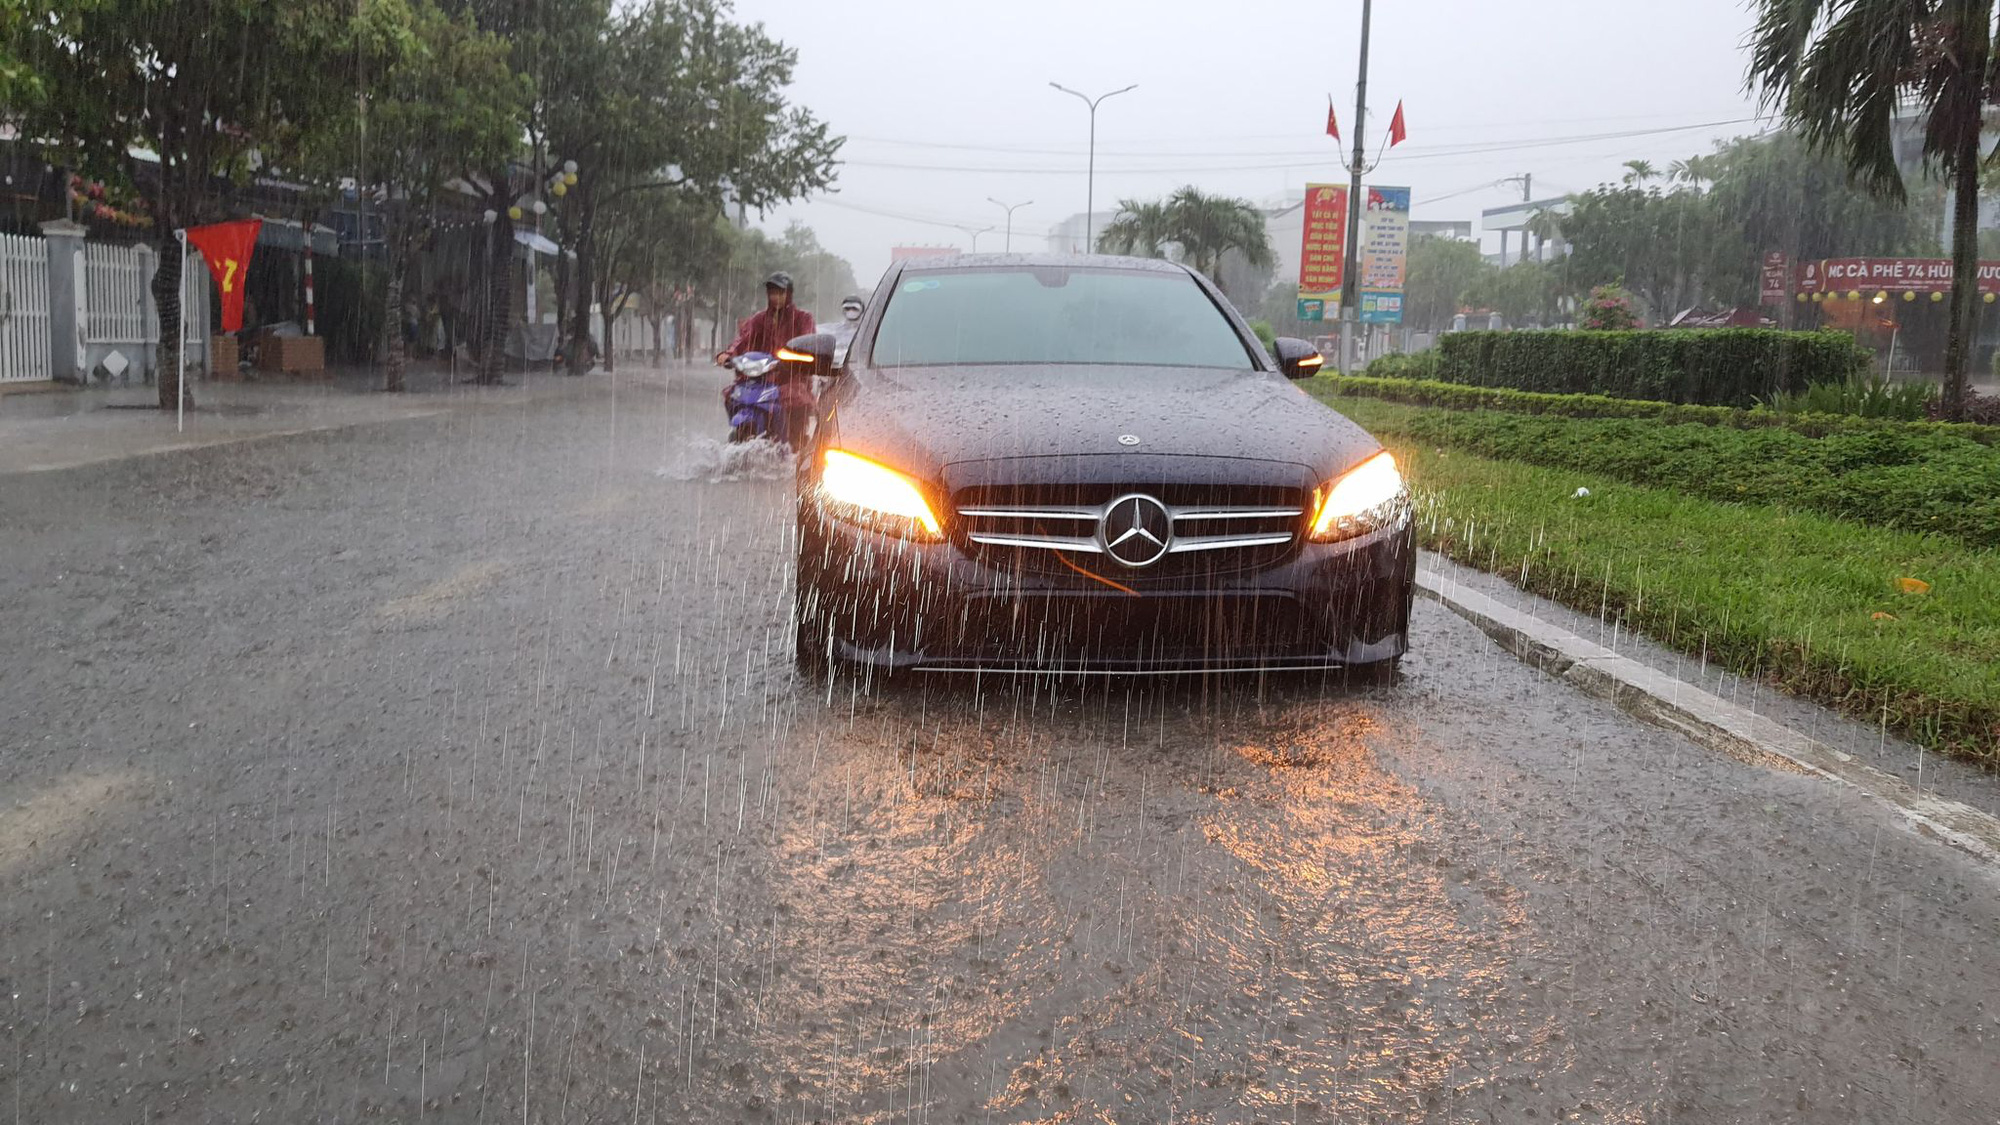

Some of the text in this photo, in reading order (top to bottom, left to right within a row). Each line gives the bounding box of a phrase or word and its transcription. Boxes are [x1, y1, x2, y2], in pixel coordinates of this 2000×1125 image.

[1847, 260, 1869, 277] CÀ
[1873, 261, 1904, 278] PHÊ
[1907, 264, 1925, 278] 74
